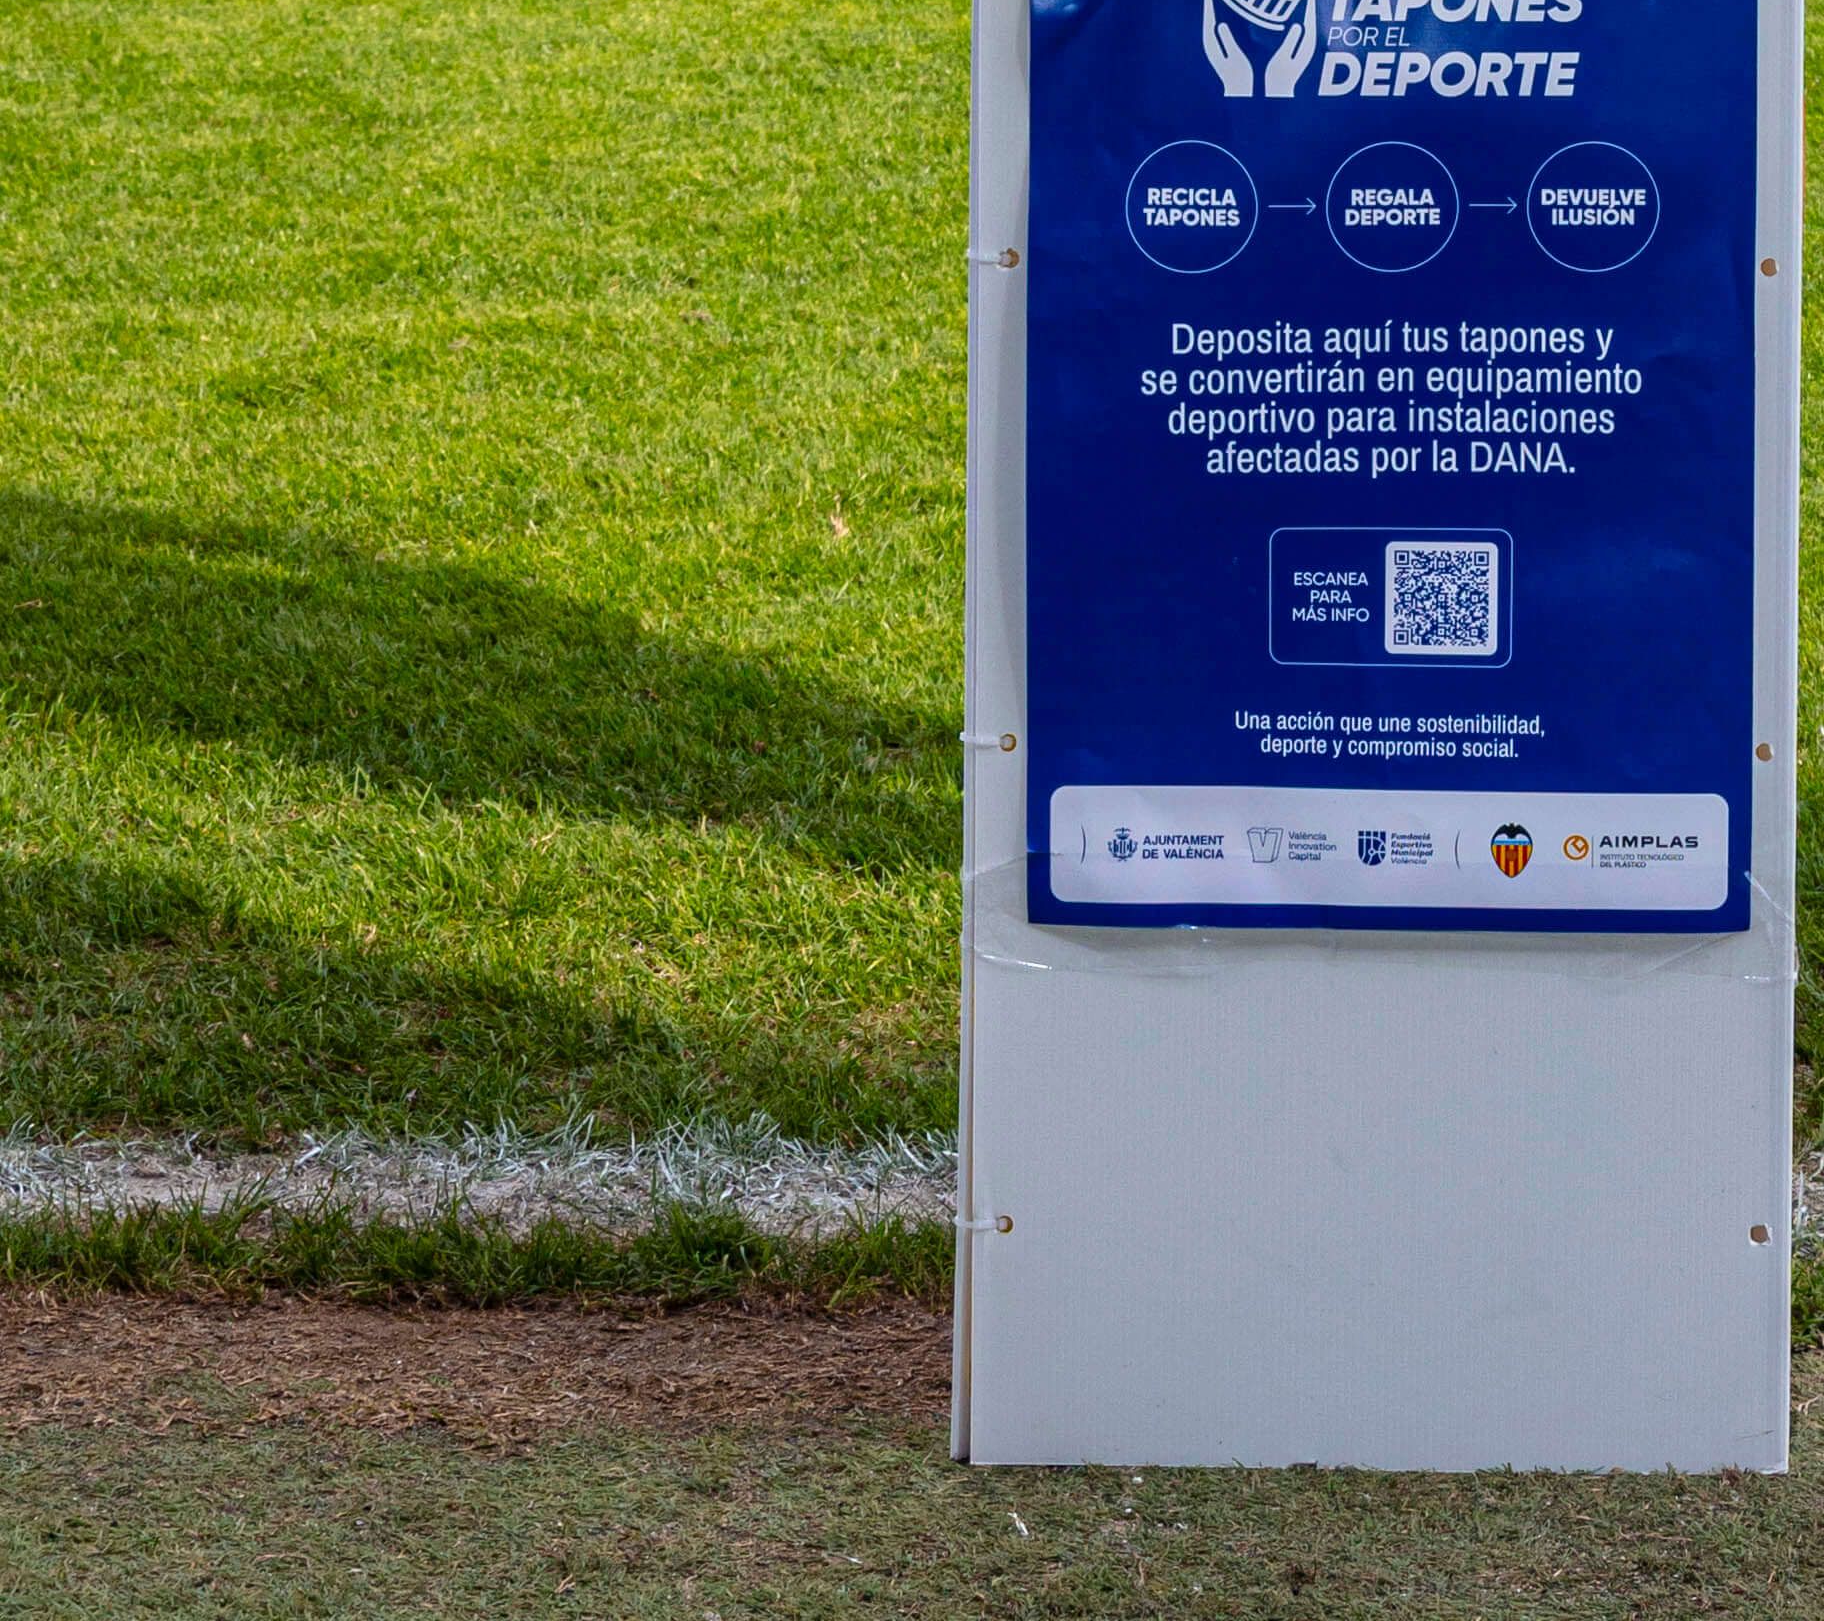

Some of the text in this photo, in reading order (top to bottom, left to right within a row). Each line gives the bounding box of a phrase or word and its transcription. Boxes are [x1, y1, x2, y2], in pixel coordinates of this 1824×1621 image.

[1326, 26, 1410, 47] POR EL
[1318, 51, 1580, 98] DEPORTE
[1146, 188, 1237, 207] RECICLA
[1350, 188, 1435, 207] REGALA
[1541, 188, 1646, 207] DEVUELVE
[1142, 207, 1241, 227] TAPONES
[1344, 207, 1441, 227] DEPORTE
[1551, 203, 1635, 227] ILUSIÓN
[1172, 319, 1614, 361] Deposita aquí tus tapones y
[1141, 360, 1642, 400] se convertirán en equipamiento
[1168, 399, 1616, 441] deportivo para instalaciones
[1206, 439, 1576, 479] afectadas por la DANA.
[1293, 572, 1369, 586] ESCANEA
[1310, 590, 1352, 604] PARA
[1292, 605, 1370, 623] MÁS INFO
[1234, 710, 1545, 738] Una acción que une sostenibilidad,
[1260, 734, 1519, 760] deporte y compromiso social.
[1142, 835, 1225, 846] AJUNTAMENT
[1599, 835, 1699, 848] AIMPLAS
[1142, 849, 1159, 859] DE
